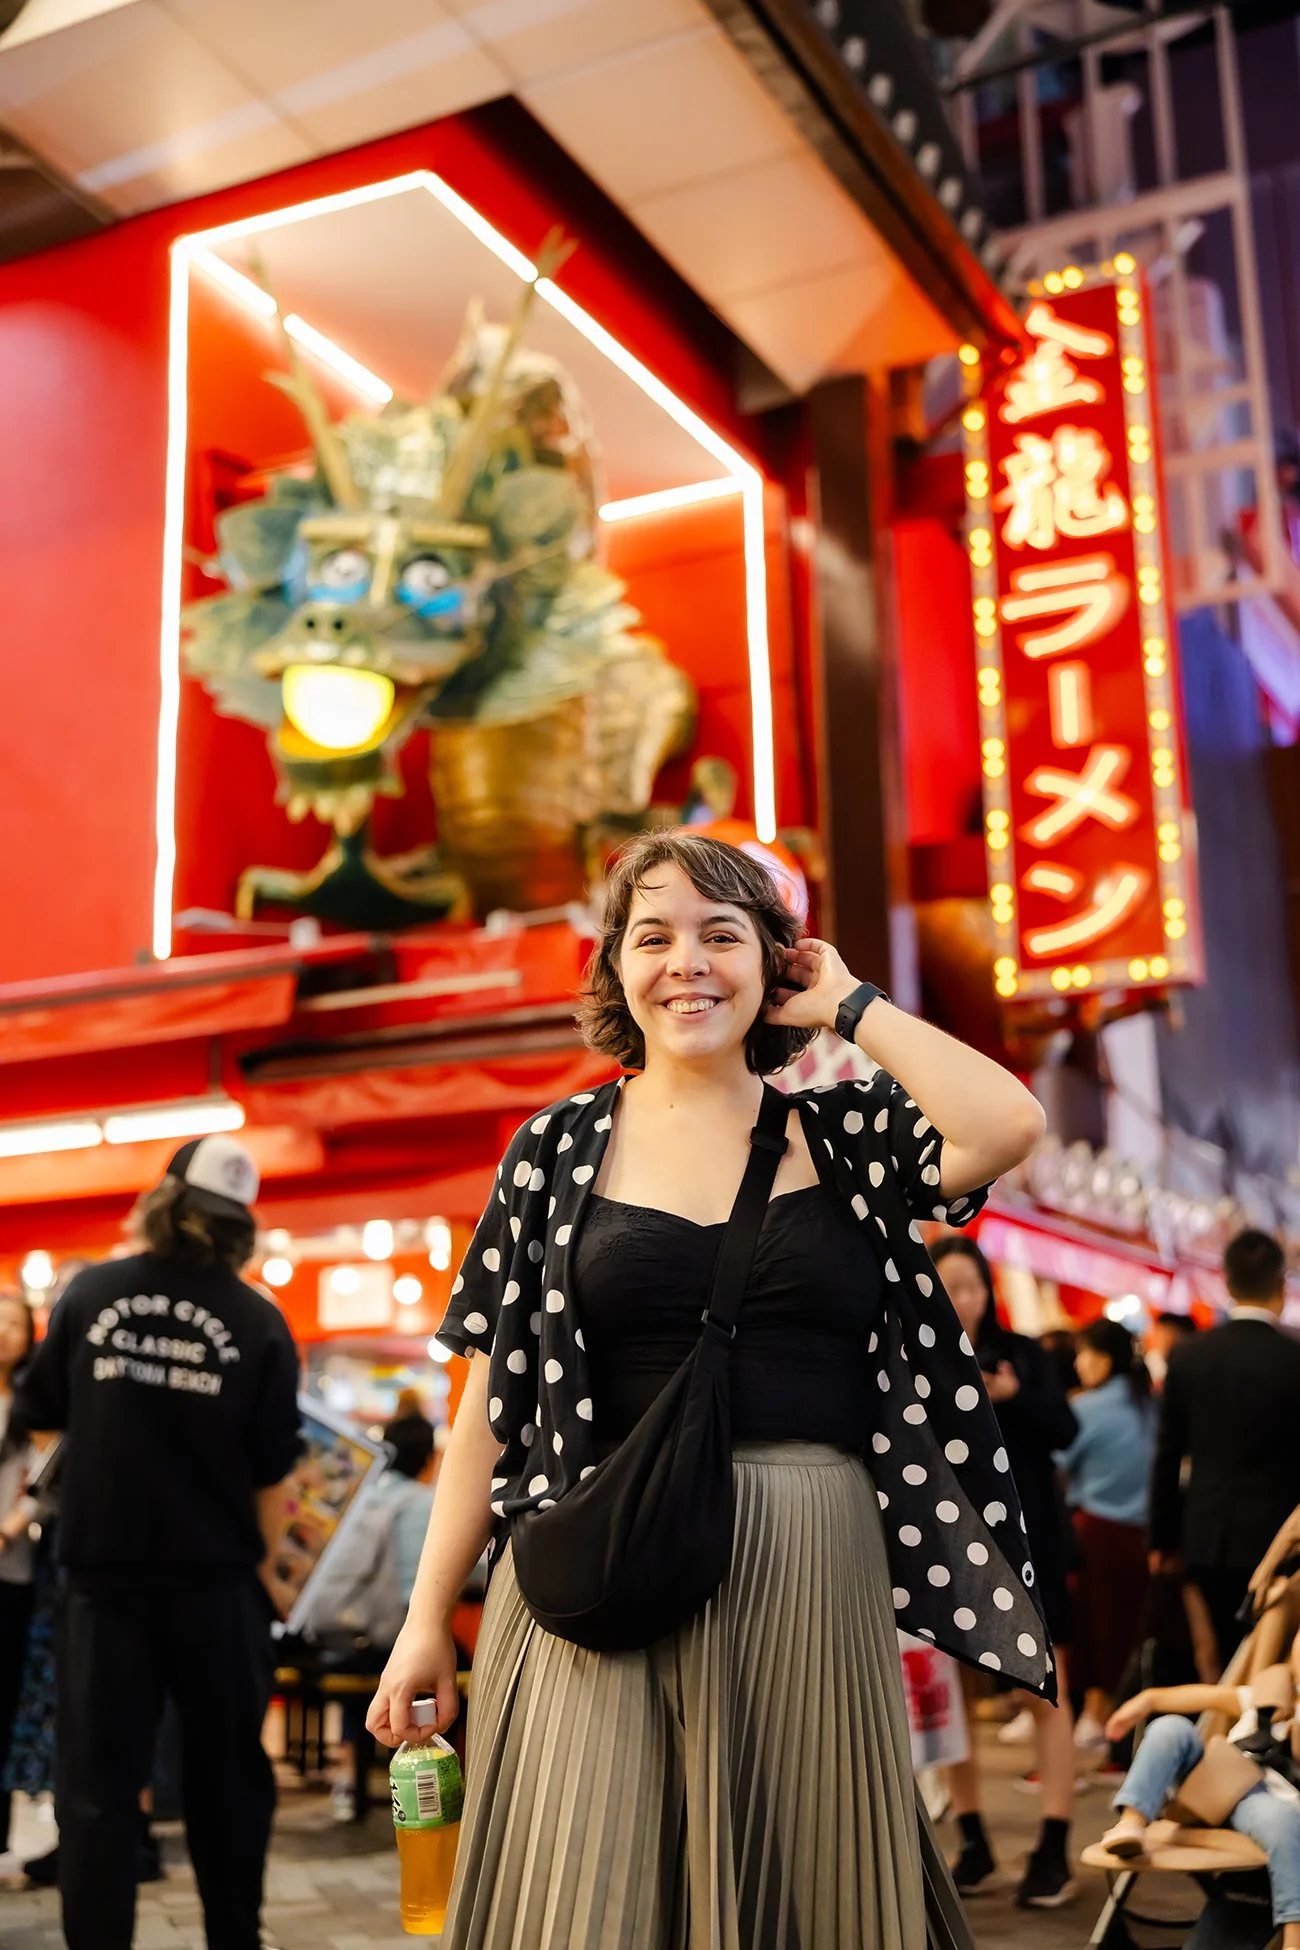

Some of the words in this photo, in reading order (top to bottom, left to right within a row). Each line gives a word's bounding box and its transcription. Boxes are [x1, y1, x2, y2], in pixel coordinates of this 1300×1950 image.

[1000, 304, 1144, 956] 金龍ラーメン
[87, 1294, 170, 1346] MOTOR
[174, 1300, 241, 1365] CYCLE
[112, 1329, 207, 1364] CLASSIC
